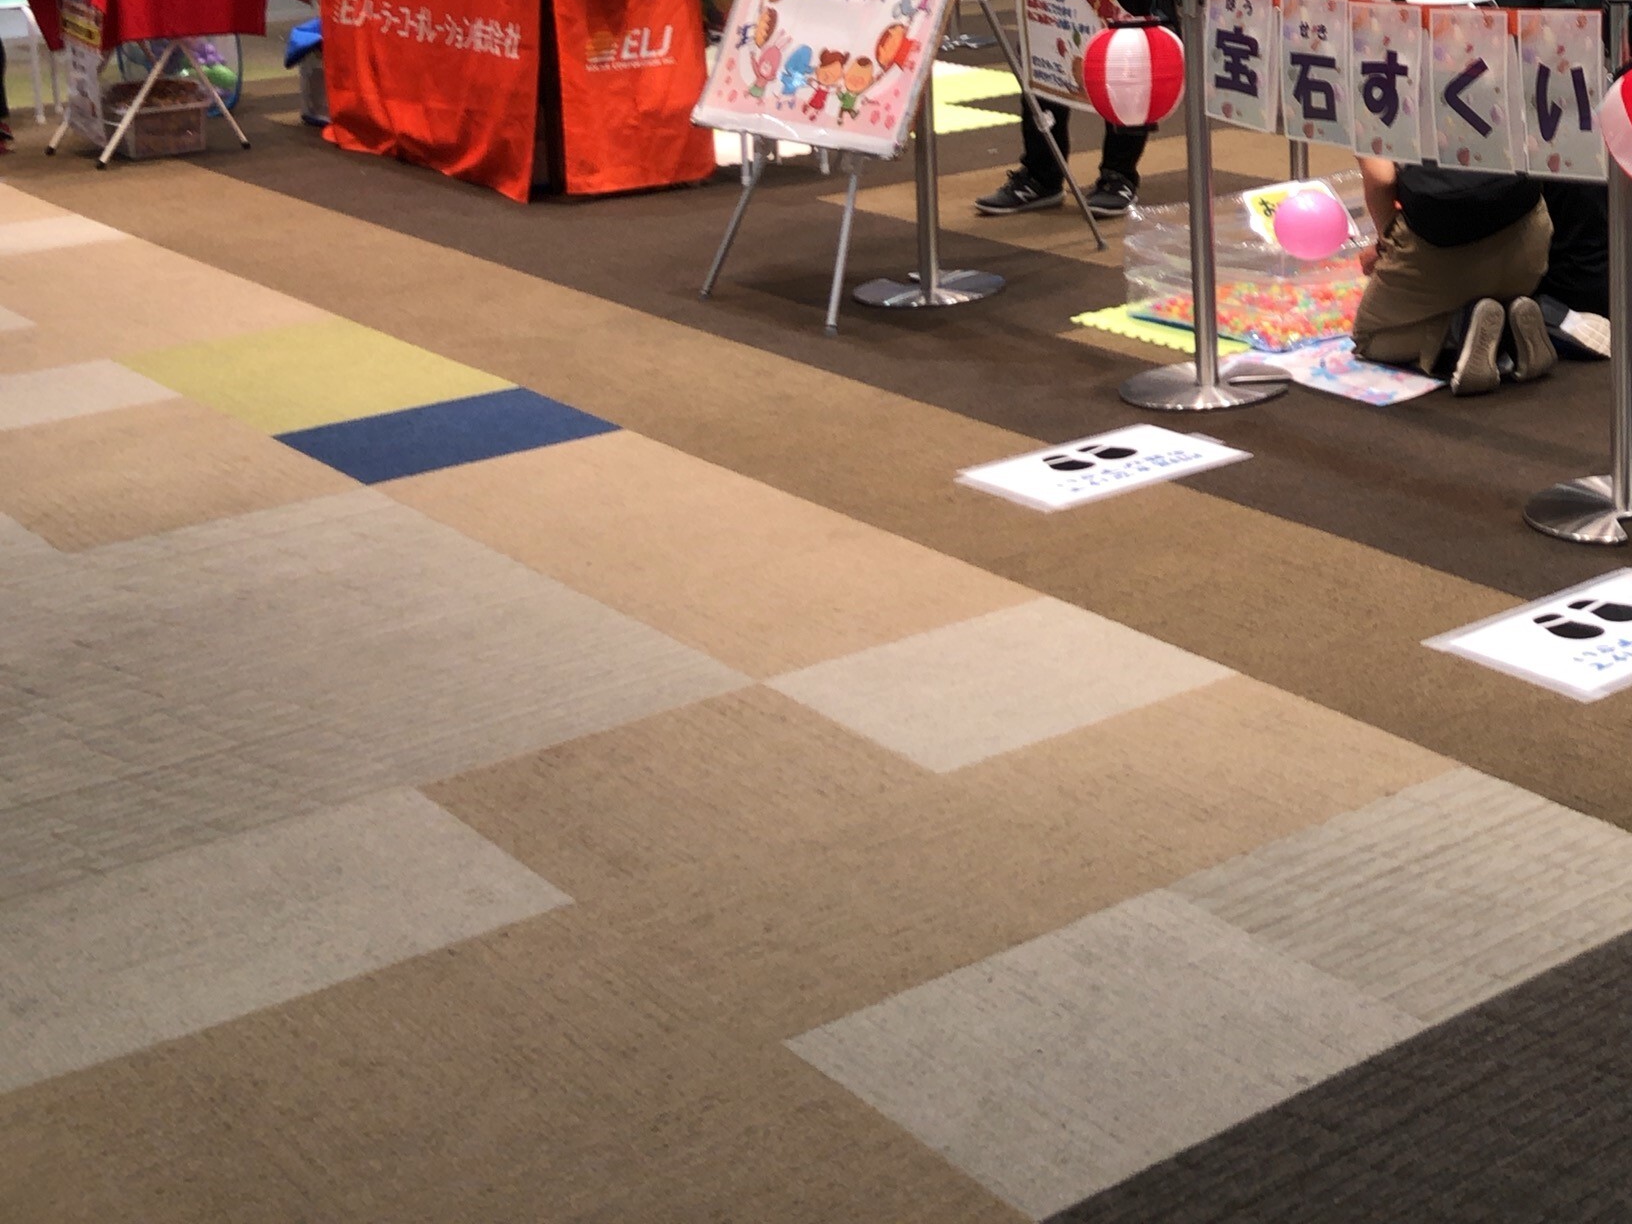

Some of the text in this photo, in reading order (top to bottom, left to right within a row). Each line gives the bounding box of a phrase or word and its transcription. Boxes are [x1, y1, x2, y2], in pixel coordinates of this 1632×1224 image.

[1214, 25, 1592, 142] 宝石すくい
